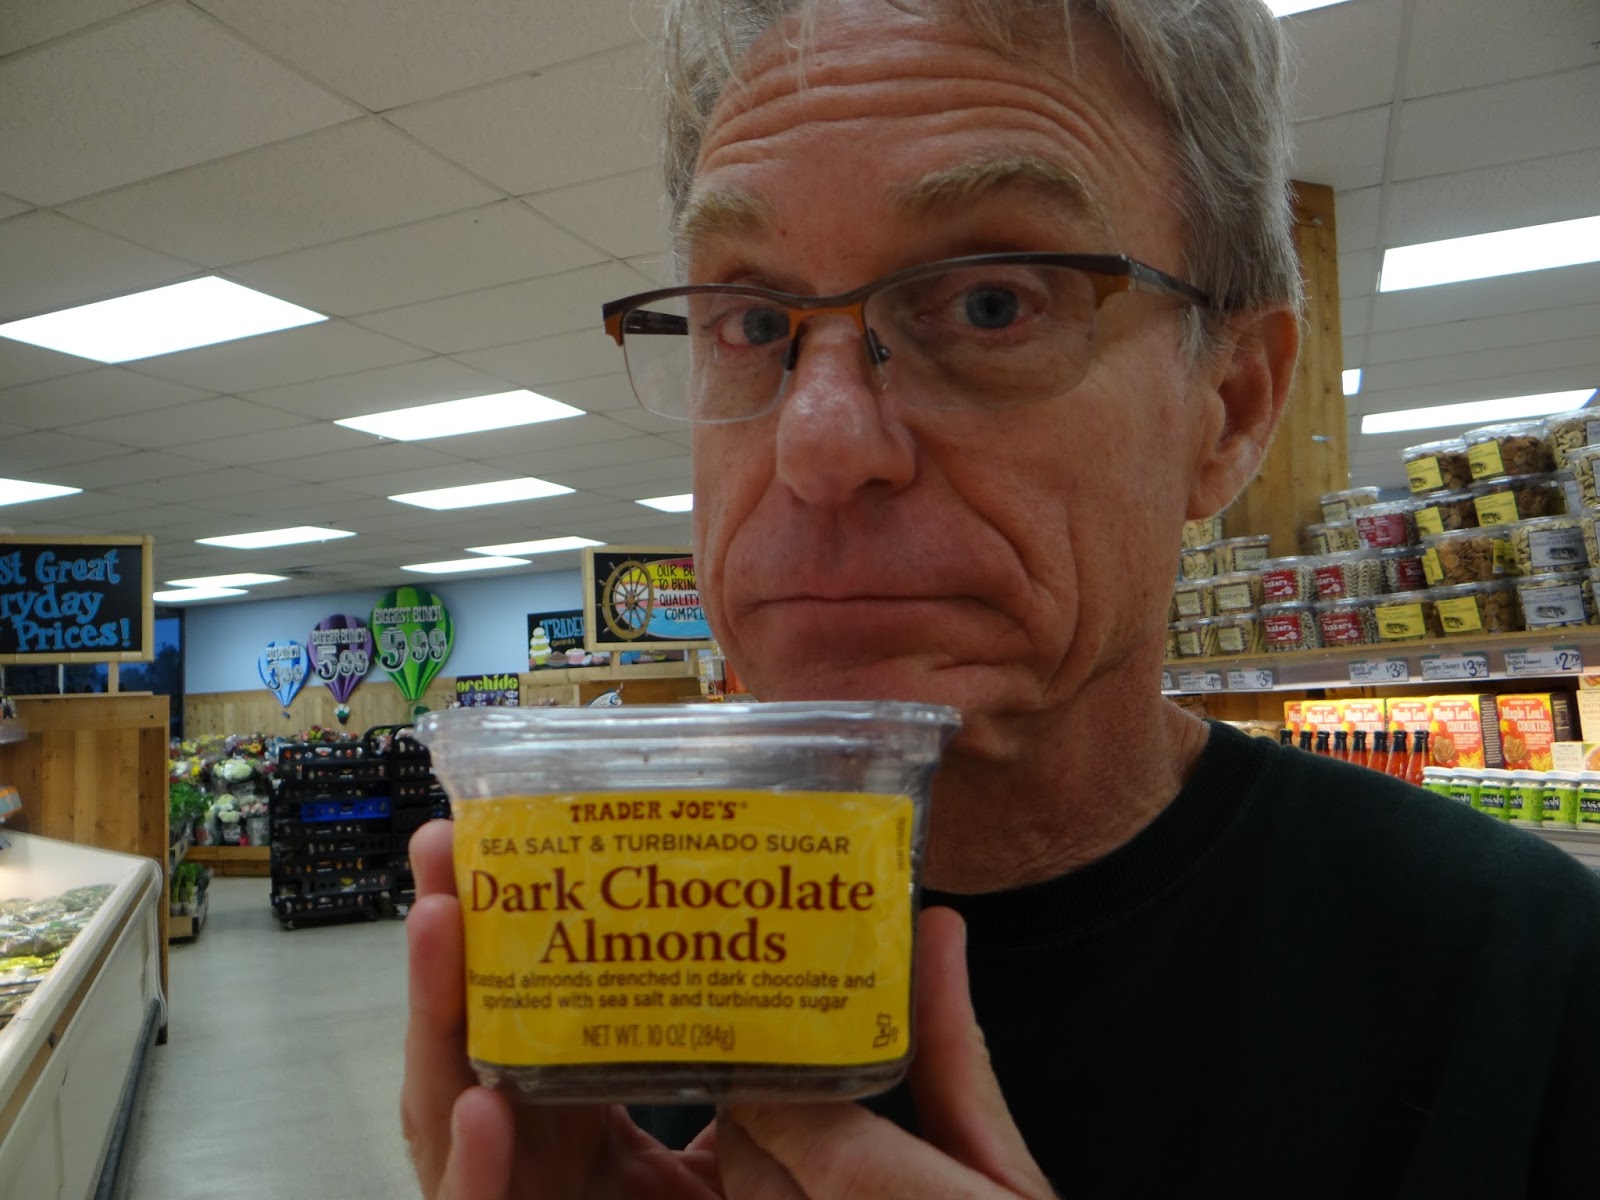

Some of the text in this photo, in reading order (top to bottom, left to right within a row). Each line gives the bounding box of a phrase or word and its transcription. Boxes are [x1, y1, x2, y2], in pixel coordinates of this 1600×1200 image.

[35, 549, 121, 584] Great
[657, 564, 677, 577] OUR
[658, 578, 669, 591] TO
[660, 593, 700, 607] QUALITY
[413, 605, 442, 622] BUNCH
[12, 617, 131, 652] Prices!
[540, 616, 585, 640] TRADE
[456, 673, 519, 693] orchids
[569, 801, 662, 823] TRADER
[480, 833, 850, 856] SEA SALT & TURBINADO SUGAR
[470, 863, 875, 913] Dark Chocolate
[538, 916, 788, 964] Almonds
[521, 972, 593, 988] almonds
[597, 970, 681, 988] drenched
[685, 971, 703, 987] in
[706, 970, 747, 987] dark
[751, 970, 838, 988] chocolate
[843, 971, 876, 989] and
[482, 990, 849, 1013] sprinkled with sea salt and turbinado sugar
[582, 1023, 736, 1051] NET WT. 10 OZ (284g)
